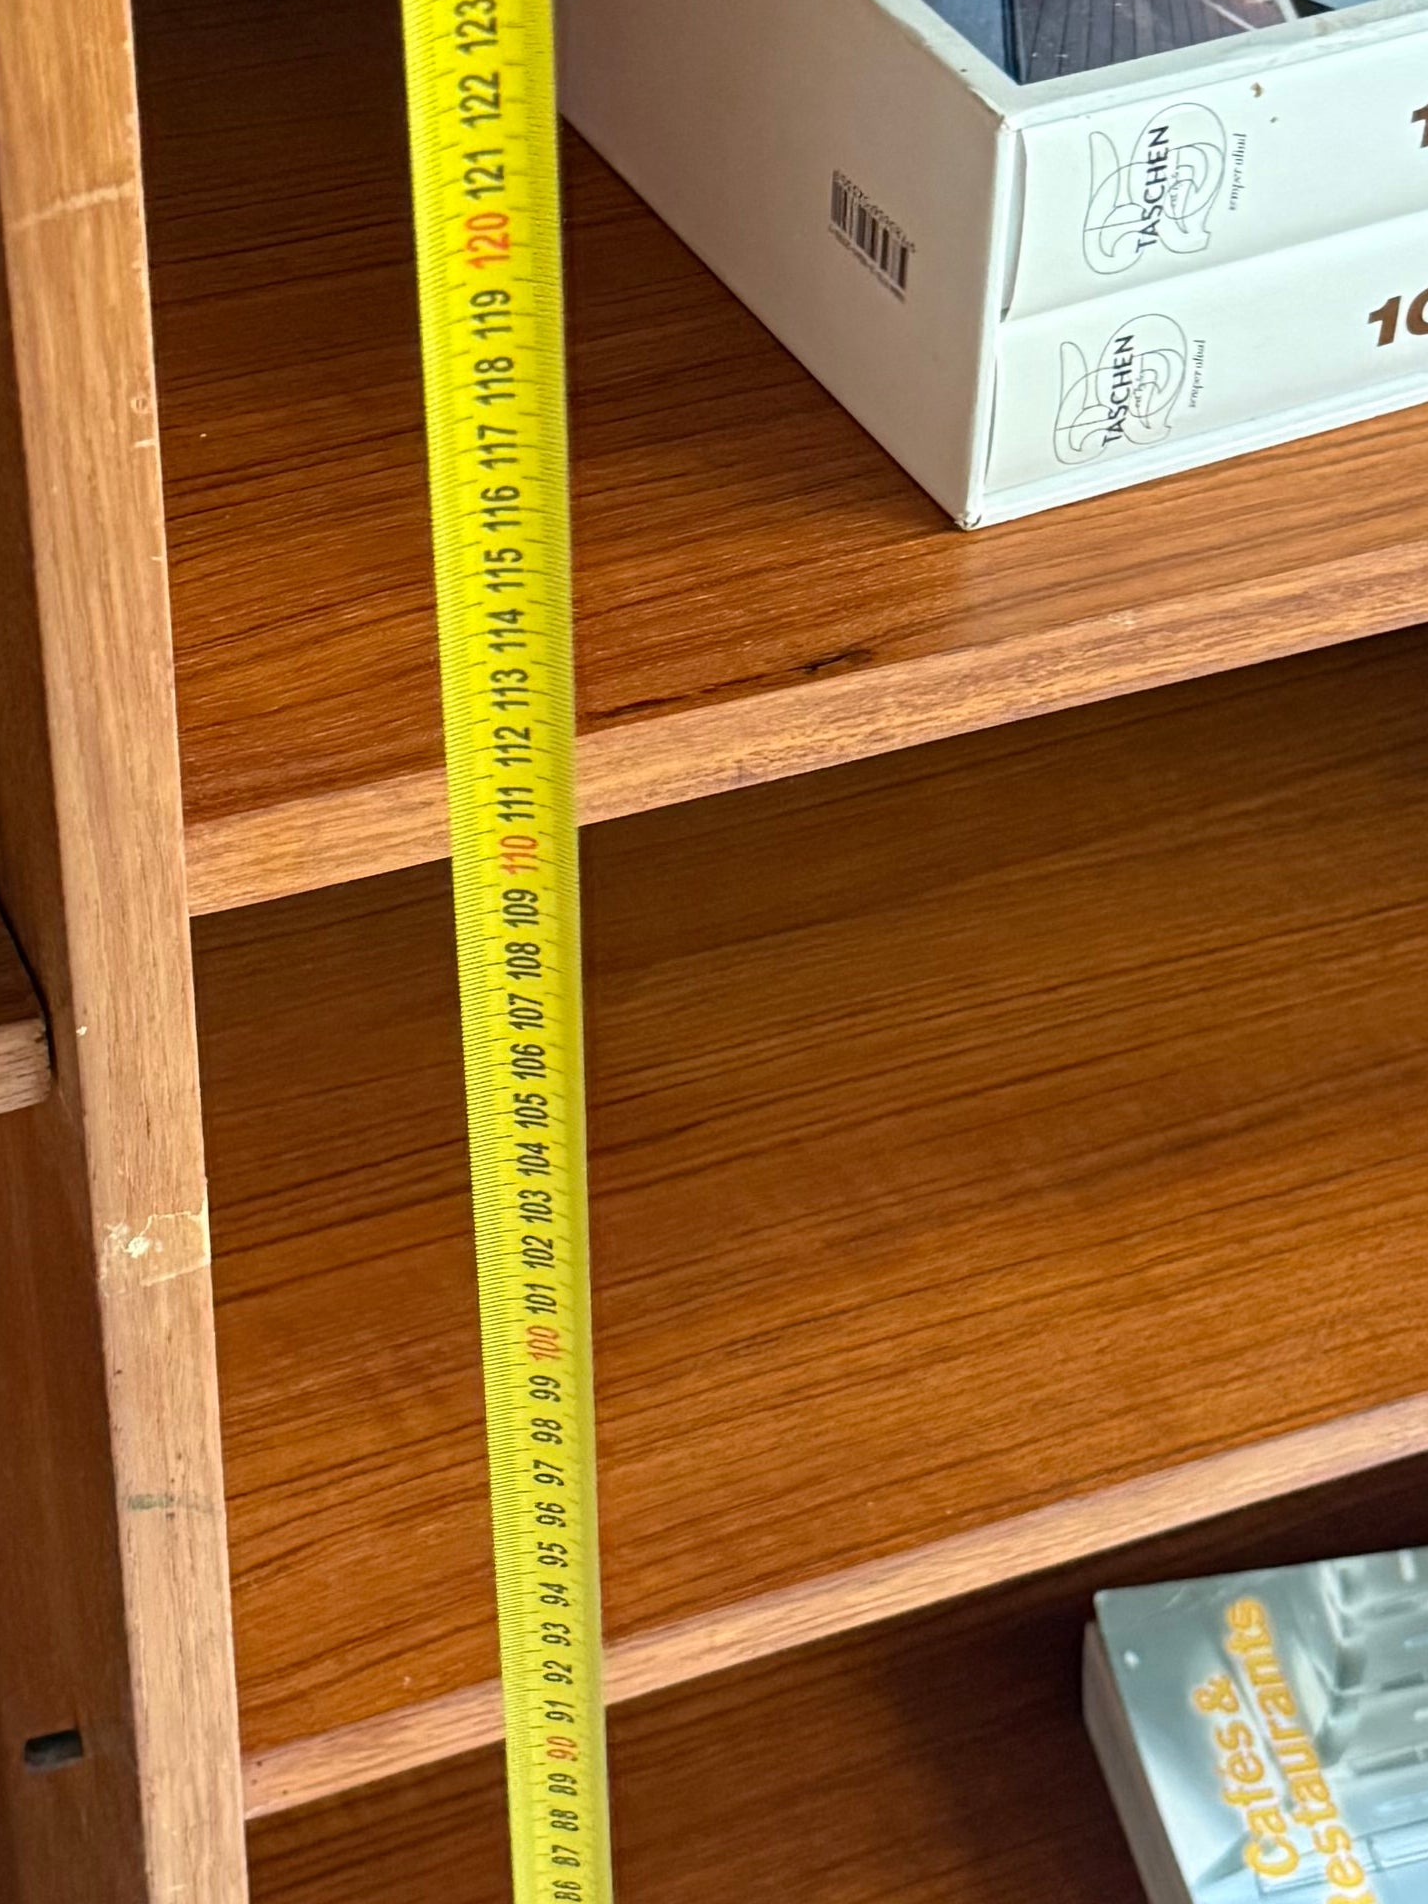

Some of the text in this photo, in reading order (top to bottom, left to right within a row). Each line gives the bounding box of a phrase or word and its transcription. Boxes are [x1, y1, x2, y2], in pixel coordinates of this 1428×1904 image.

[458, 72, 502, 129] 122
[462, 147, 505, 201] 121
[1135, 124, 1171, 253] TASCHEN
[465, 210, 508, 270] 120
[470, 288, 512, 341] 119
[473, 355, 515, 406] 118
[1101, 334, 1135, 447] TASCHEN
[477, 422, 518, 471] 117
[481, 484, 521, 533] 116
[484, 546, 523, 594] 115
[487, 608, 526, 654] 114
[491, 667, 529, 712] 113
[494, 724, 531, 768] 112
[497, 785, 534, 823] 111
[500, 834, 536, 875] 110
[503, 887, 539, 929] 109
[505, 940, 541, 981] 108
[508, 991, 543, 1032] 107
[511, 1042, 546, 1081] 106
[513, 1091, 548, 1130] 105
[516, 1141, 550, 1178] 104
[518, 1188, 552, 1225] 103
[521, 1233, 554, 1270] 102
[523, 1281, 556, 1316] 101
[525, 1324, 558, 1362] 100
[528, 1373, 560, 1404] 99
[530, 1416, 561, 1446] 98
[532, 1458, 563, 1488] 97
[534, 1500, 565, 1530] 96
[536, 1540, 567, 1570] 95
[538, 1580, 568, 1609] 94
[540, 1620, 570, 1648] 93
[542, 1659, 572, 1686] 92
[544, 1698, 573, 1724] 91
[1193, 1673, 1241, 1715] &
[545, 1734, 575, 1762] 90
[547, 1771, 576, 1798] 89
[549, 1807, 578, 1834] 88
[550, 1843, 579, 1869] 87
[552, 1878, 581, 1904] 86
